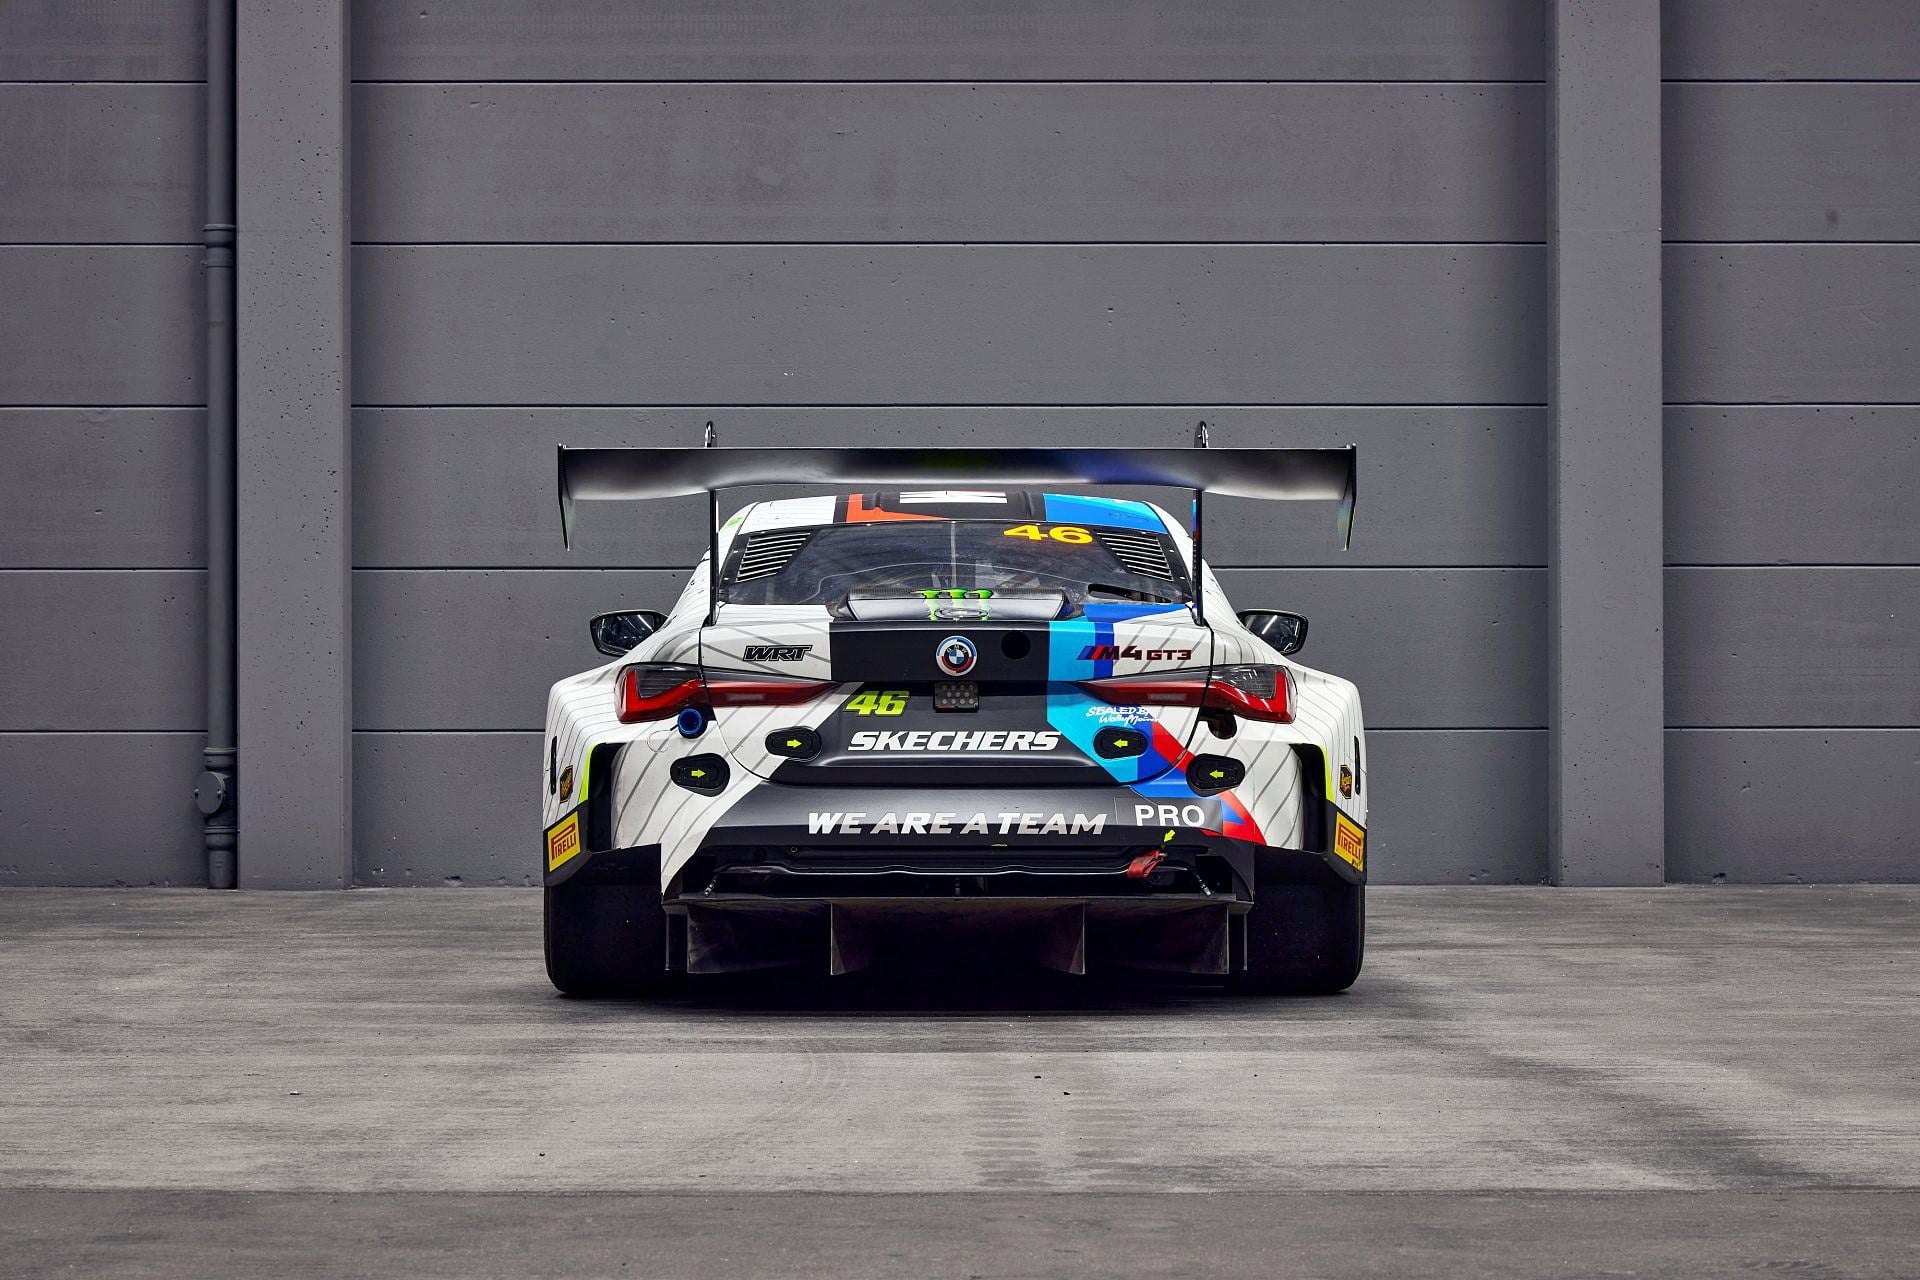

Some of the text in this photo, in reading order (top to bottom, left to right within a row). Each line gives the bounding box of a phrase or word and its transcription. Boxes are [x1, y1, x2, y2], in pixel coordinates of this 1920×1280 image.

[1003, 524, 1094, 544] 46
[743, 645, 813, 662] WRT
[1088, 646, 1192, 661] M4 GT3
[844, 690, 910, 716] 46
[1086, 706, 1136, 717] SEALED
[848, 731, 1061, 752] SKECHERS
[808, 812, 1108, 835] WE ARE A TEAM
[1134, 804, 1206, 828] PRO
[551, 822, 577, 861] PIRELLI
[1338, 823, 1362, 861] PIRELLI
